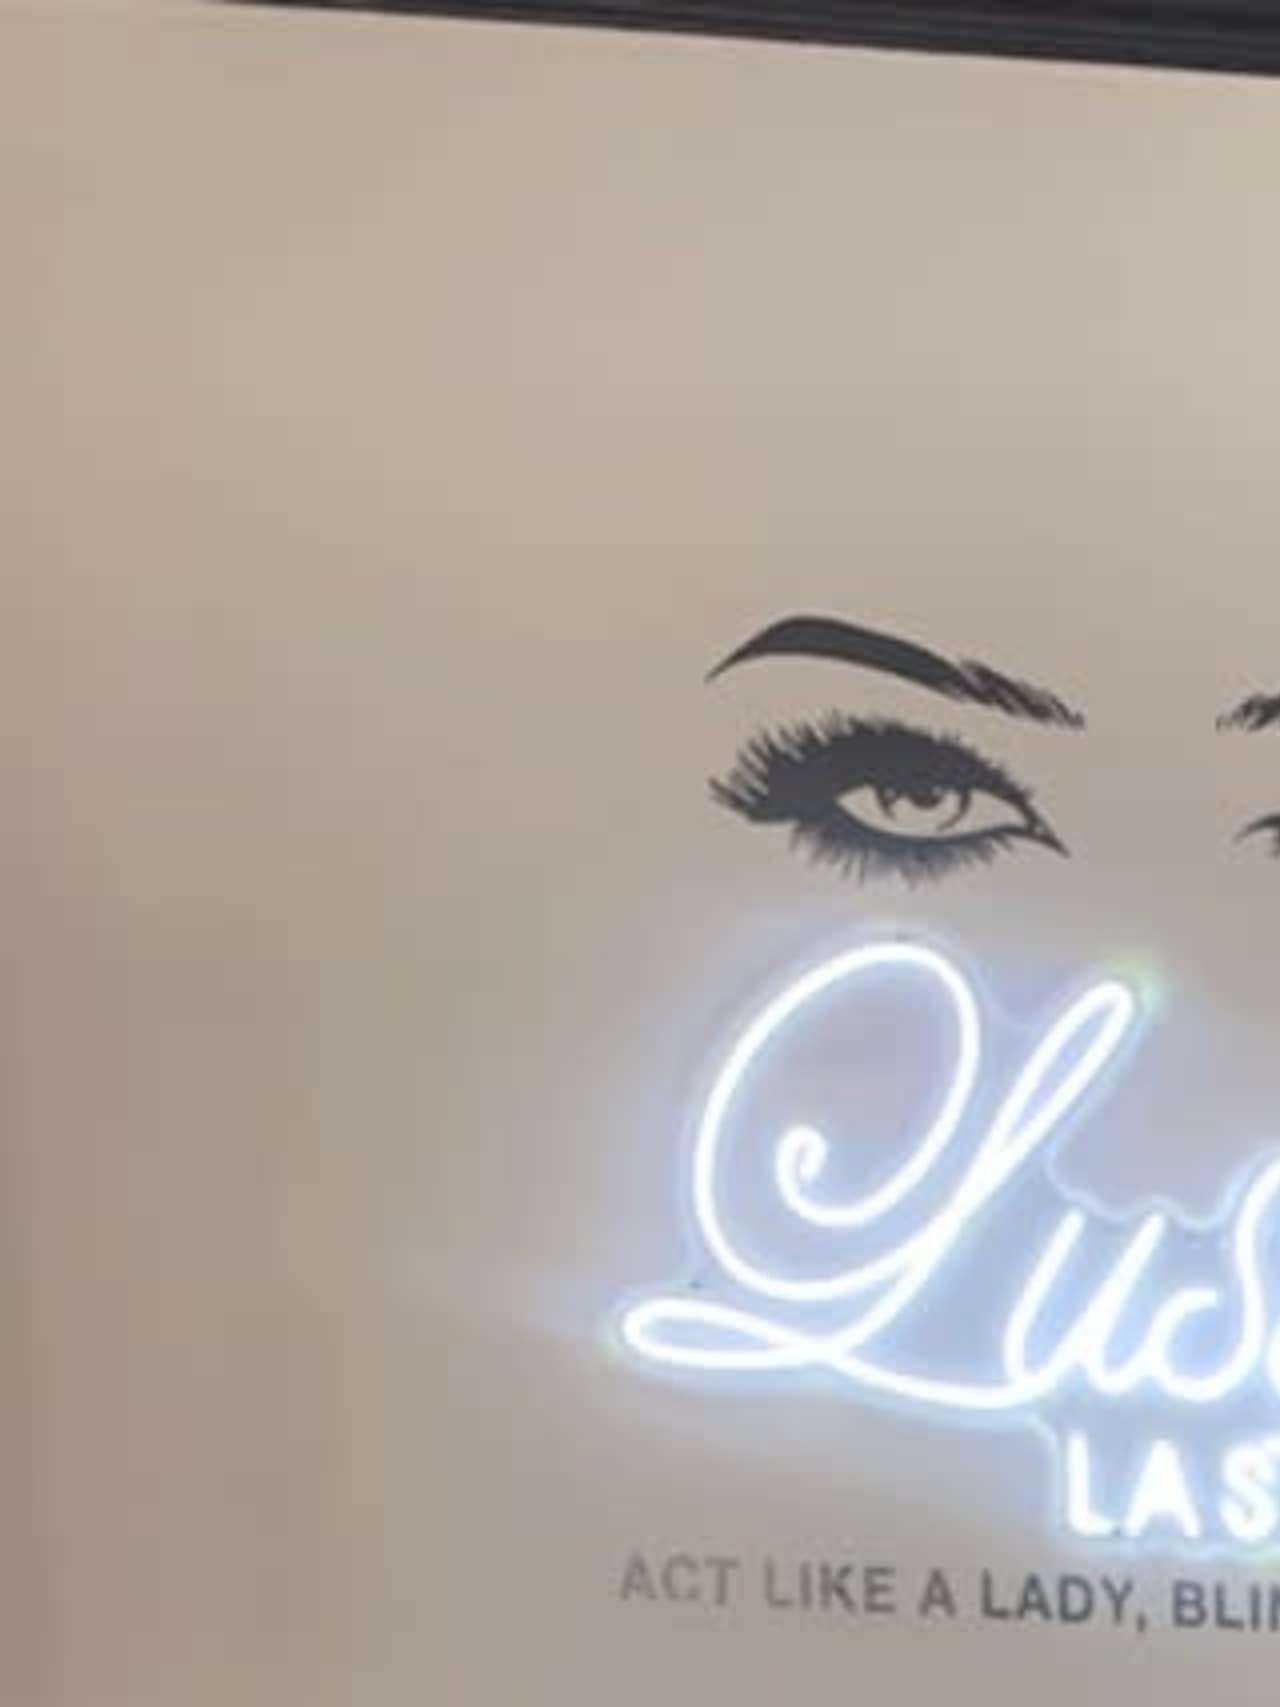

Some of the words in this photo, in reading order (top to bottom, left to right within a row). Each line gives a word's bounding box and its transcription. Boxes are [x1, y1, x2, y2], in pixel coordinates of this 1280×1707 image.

[620, 1552, 740, 1607] ACT
[763, 1560, 897, 1613] LIKE
[918, 1569, 956, 1617] A
[980, 1568, 1148, 1632] LADY,
